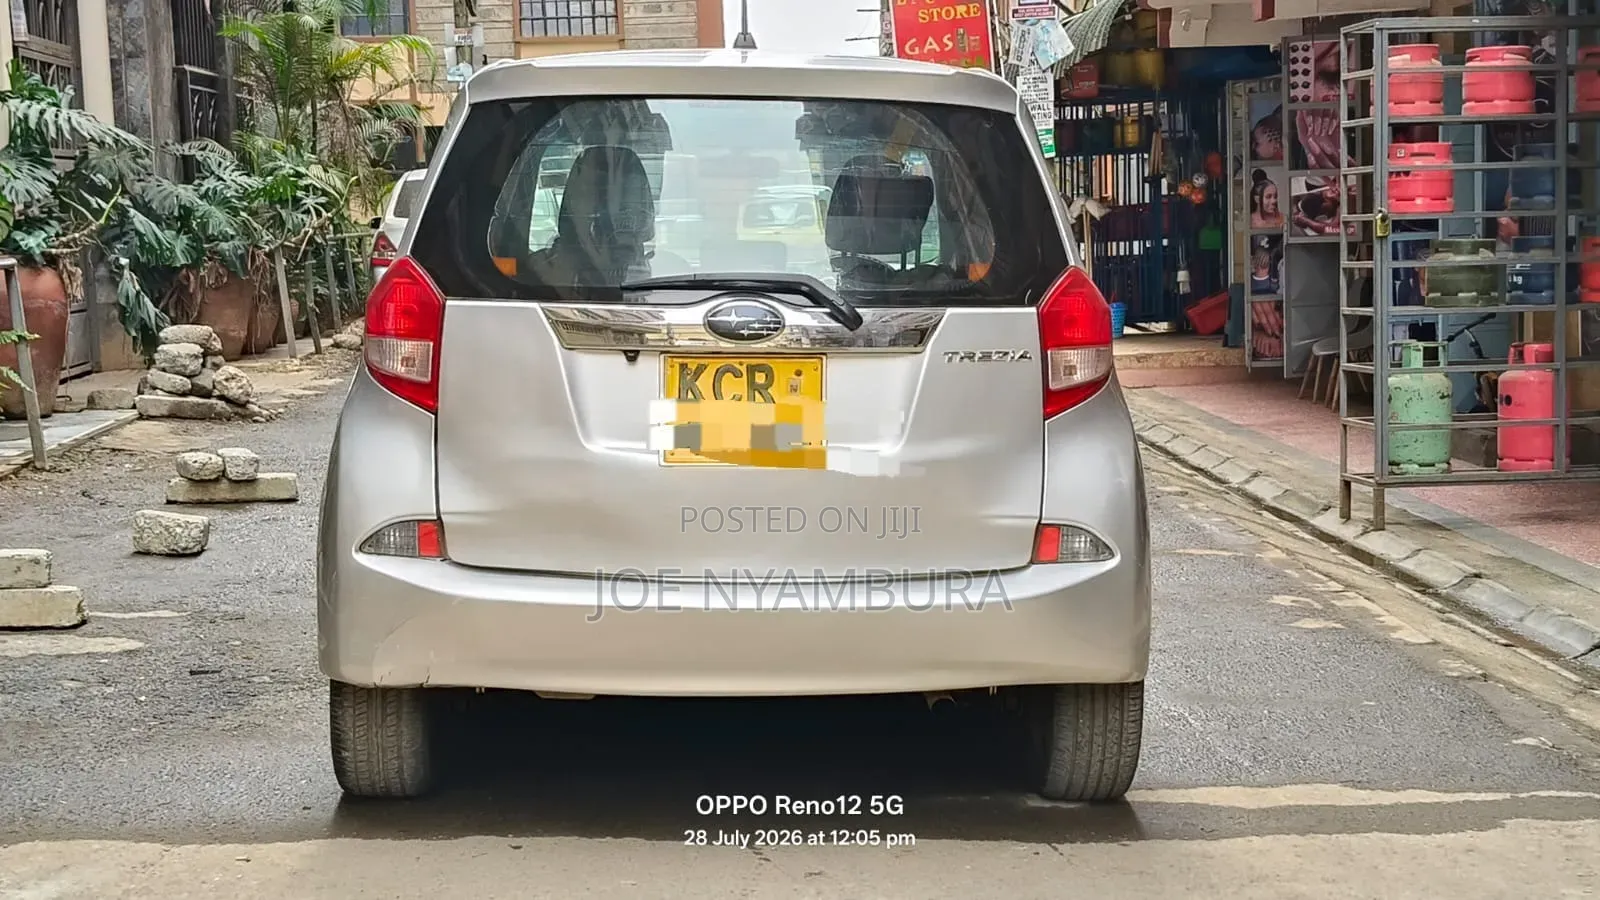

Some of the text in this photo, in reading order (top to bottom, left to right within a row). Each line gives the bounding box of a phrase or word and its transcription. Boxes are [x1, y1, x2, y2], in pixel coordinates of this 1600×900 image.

[918, 3, 981, 23] STORE
[904, 33, 954, 55] GAS
[1030, 103, 1050, 111] WALL
[1031, 111, 1052, 120] NTING
[941, 349, 1032, 363] TREZIA
[678, 363, 776, 404] KCR
